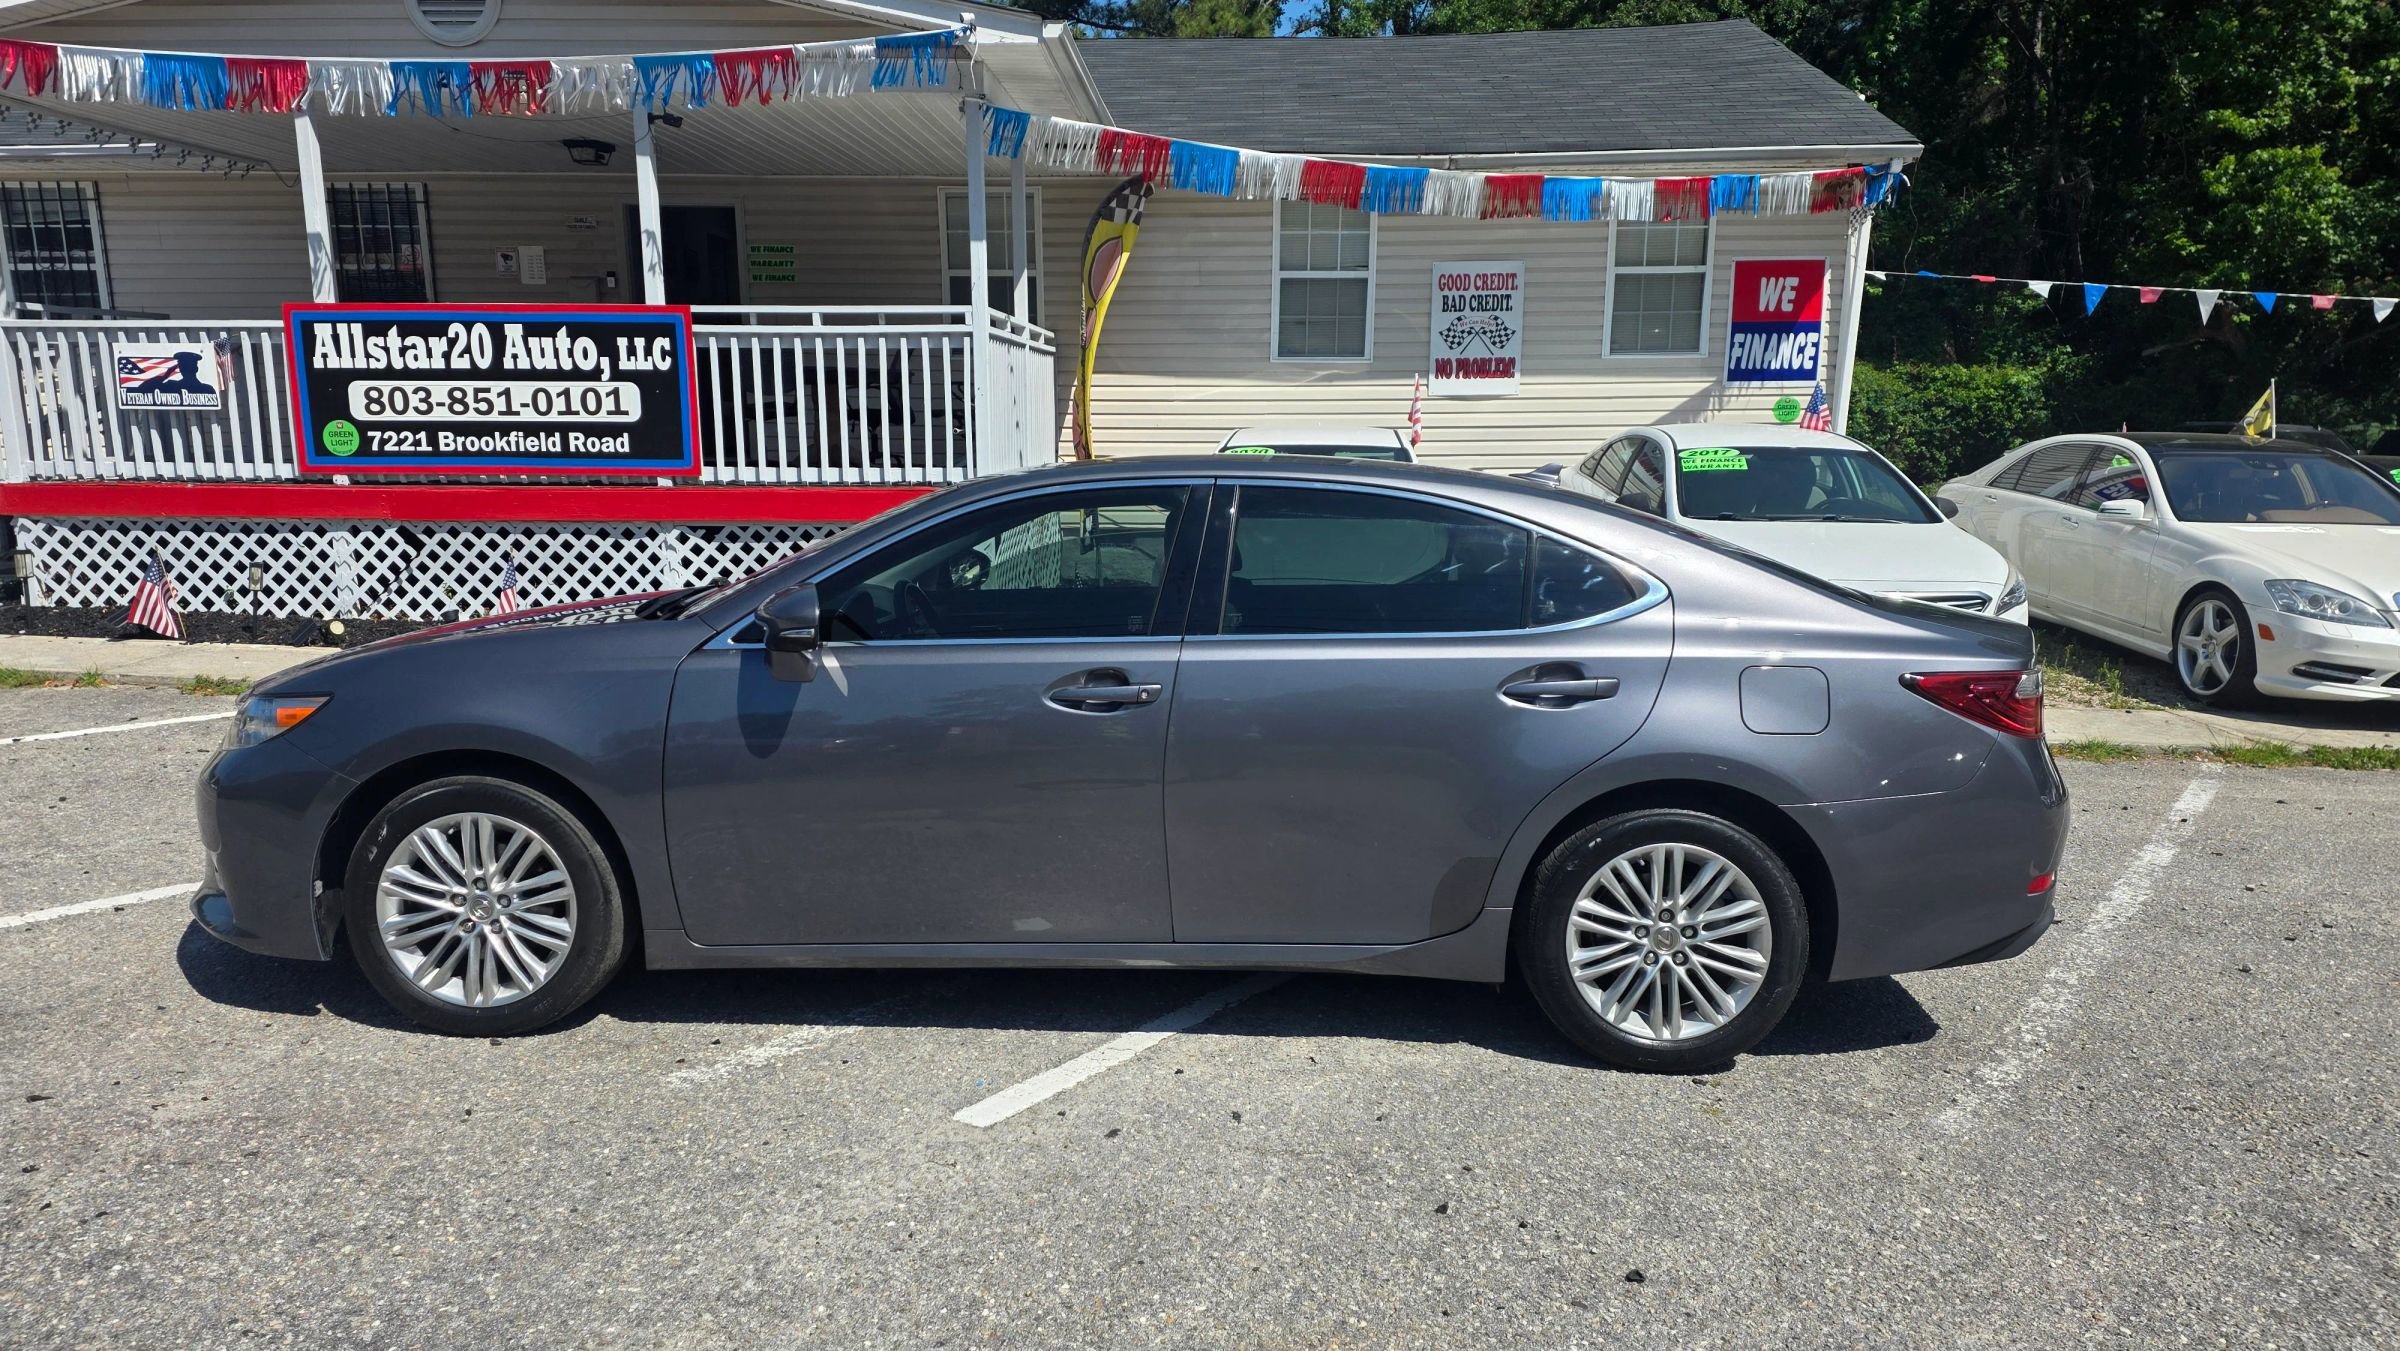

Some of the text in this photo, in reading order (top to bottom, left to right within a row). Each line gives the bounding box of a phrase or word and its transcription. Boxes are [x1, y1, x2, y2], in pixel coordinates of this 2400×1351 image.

[1438, 272, 1518, 292] GOOD CREDIT.
[1442, 294, 1513, 312] BAD CREDIT.
[1759, 277, 1799, 312] WE
[313, 322, 672, 381] Allstar20 Auto, LLC
[1730, 332, 1819, 370] FINANCE
[1434, 357, 1516, 379] NO PROBLEM!
[120, 388, 218, 406] VETERAN OWNED BUSINESS
[364, 386, 630, 416] 803-851-0101
[367, 431, 630, 453] 7221 Brookfield Road
